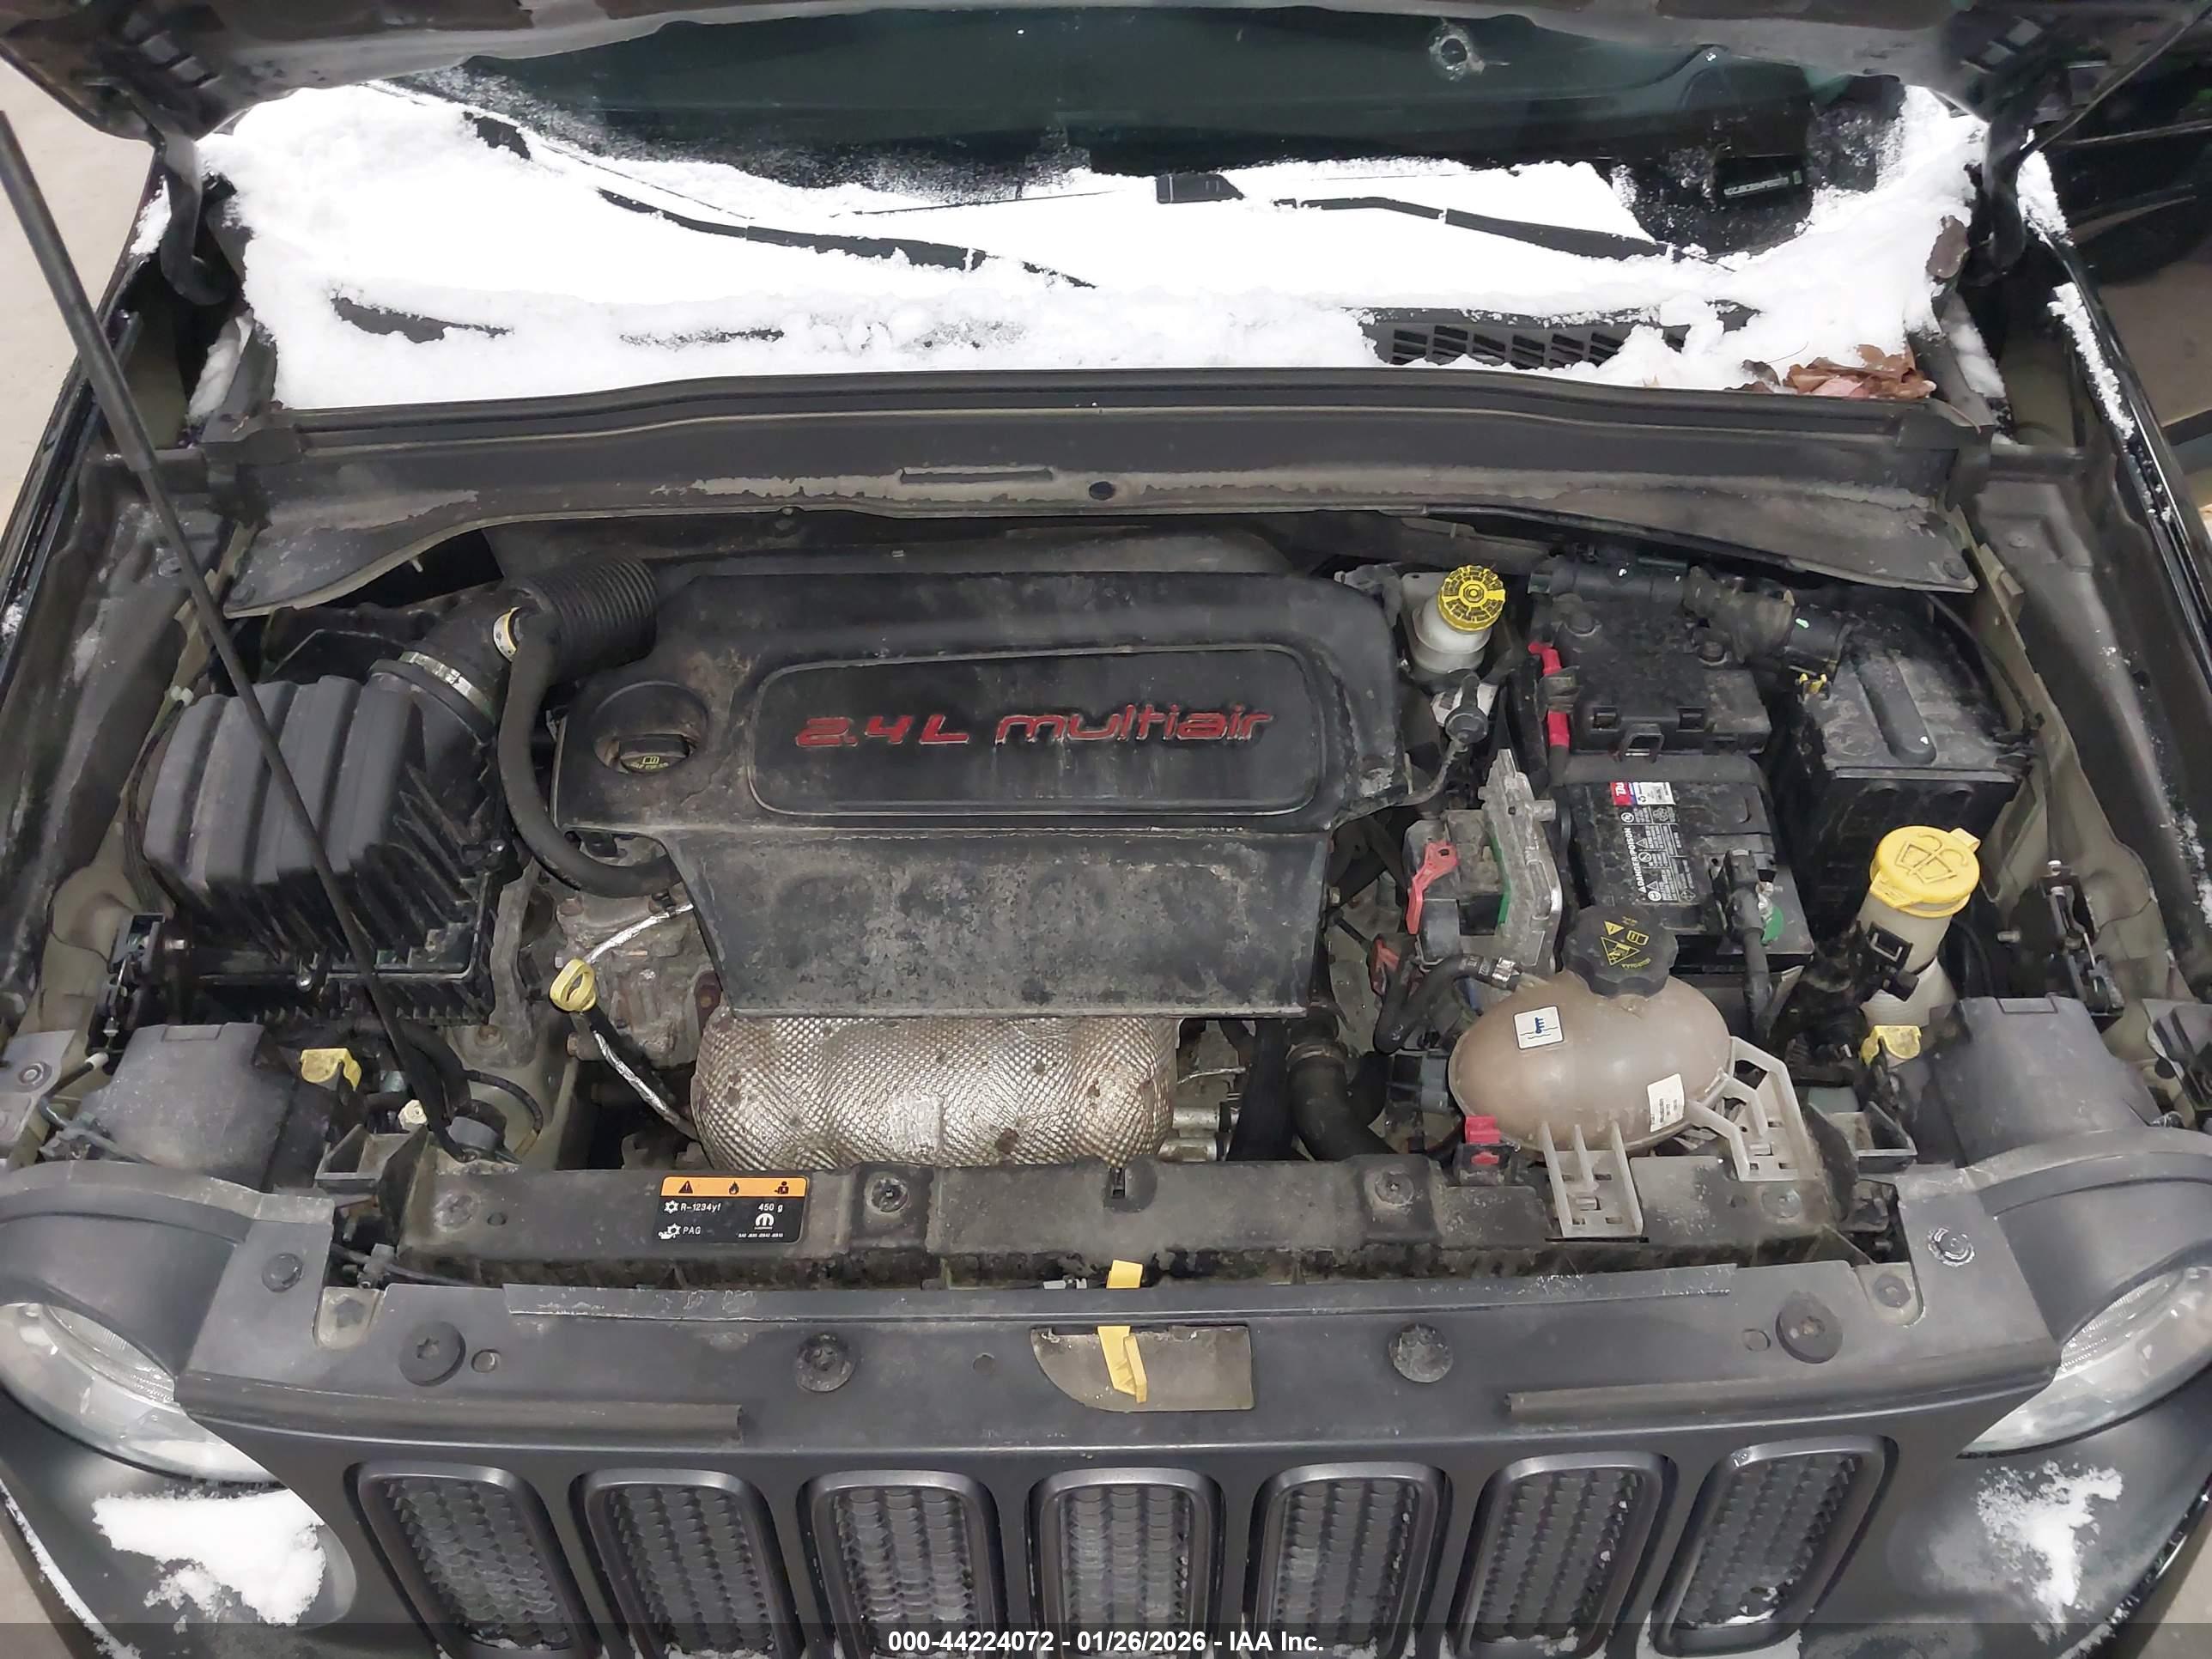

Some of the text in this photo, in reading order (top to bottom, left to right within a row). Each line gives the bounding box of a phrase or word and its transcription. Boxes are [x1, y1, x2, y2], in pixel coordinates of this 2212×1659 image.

[994, 703, 1273, 744] multiair
[1624, 827, 1645, 887] DANGER/POISON
[680, 1202, 721, 1212] R-1234yf
[758, 1203, 783, 1213] 450 g
[682, 1225, 702, 1235] PAG
